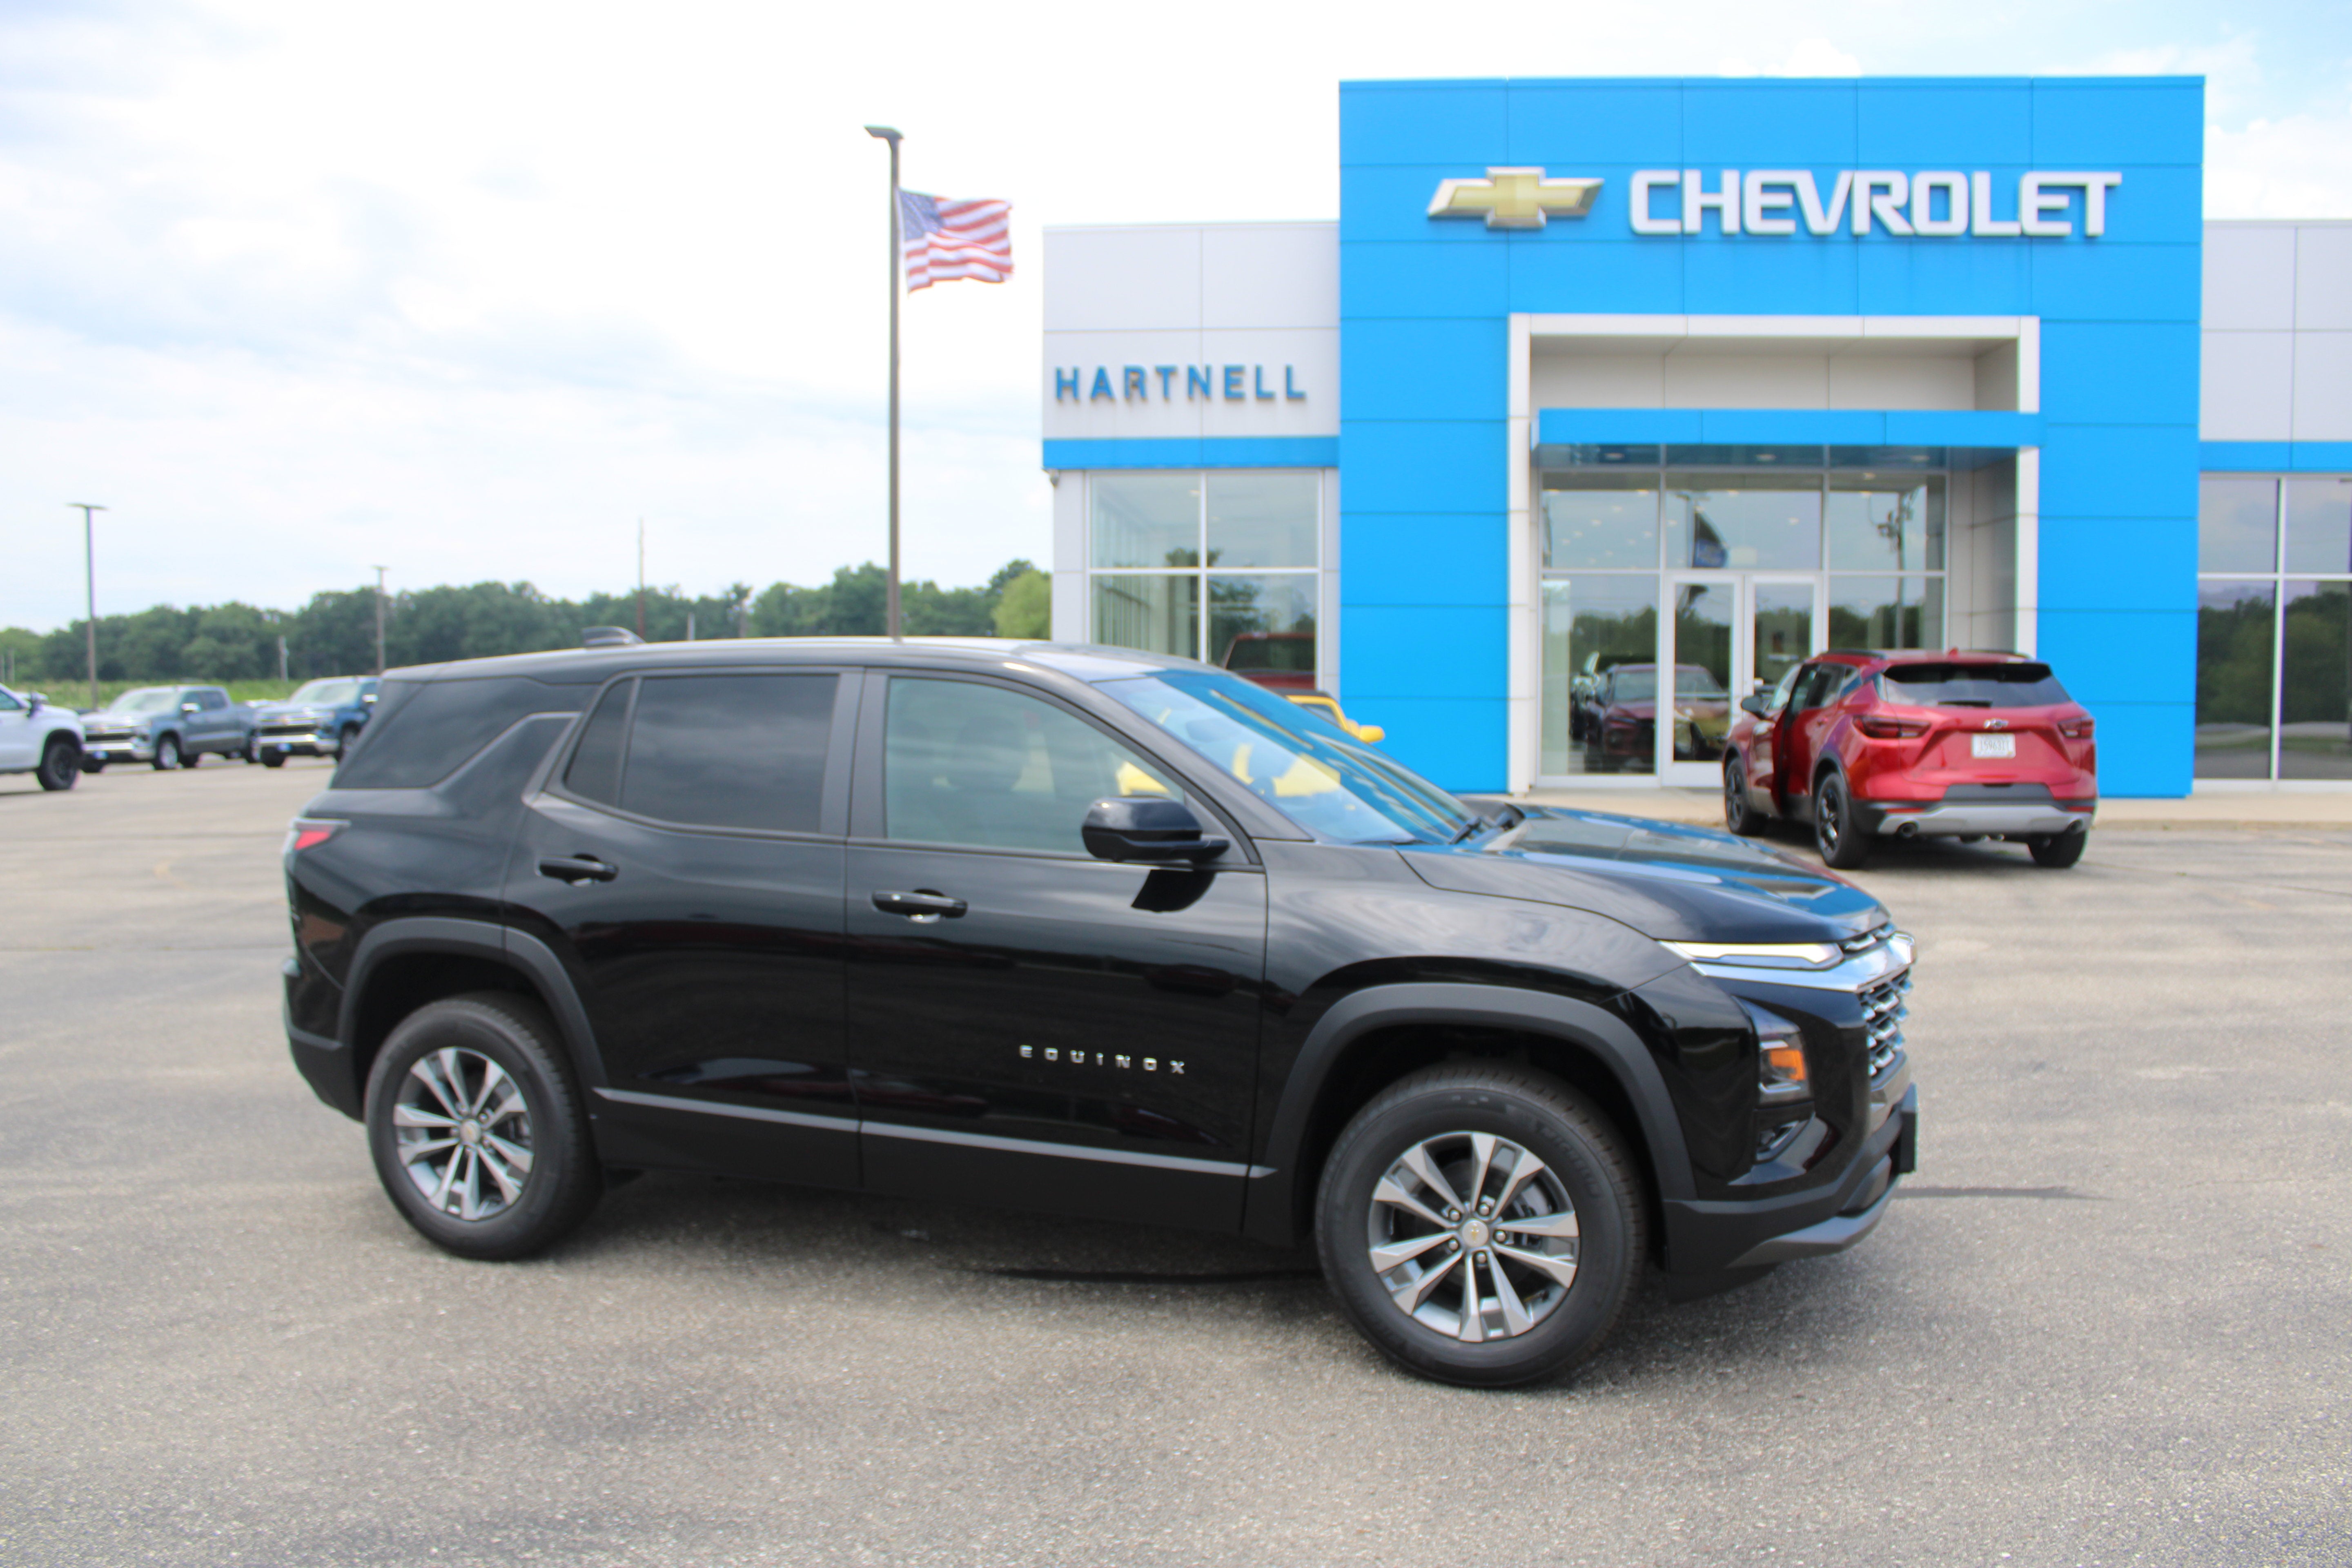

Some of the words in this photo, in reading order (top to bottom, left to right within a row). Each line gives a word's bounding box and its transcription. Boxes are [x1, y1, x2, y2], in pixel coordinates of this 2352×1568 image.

[1630, 169, 2122, 236] CHEVROLET
[1055, 365, 1307, 400] HARTNELL
[1020, 1045, 1185, 1074] EQUINOX
